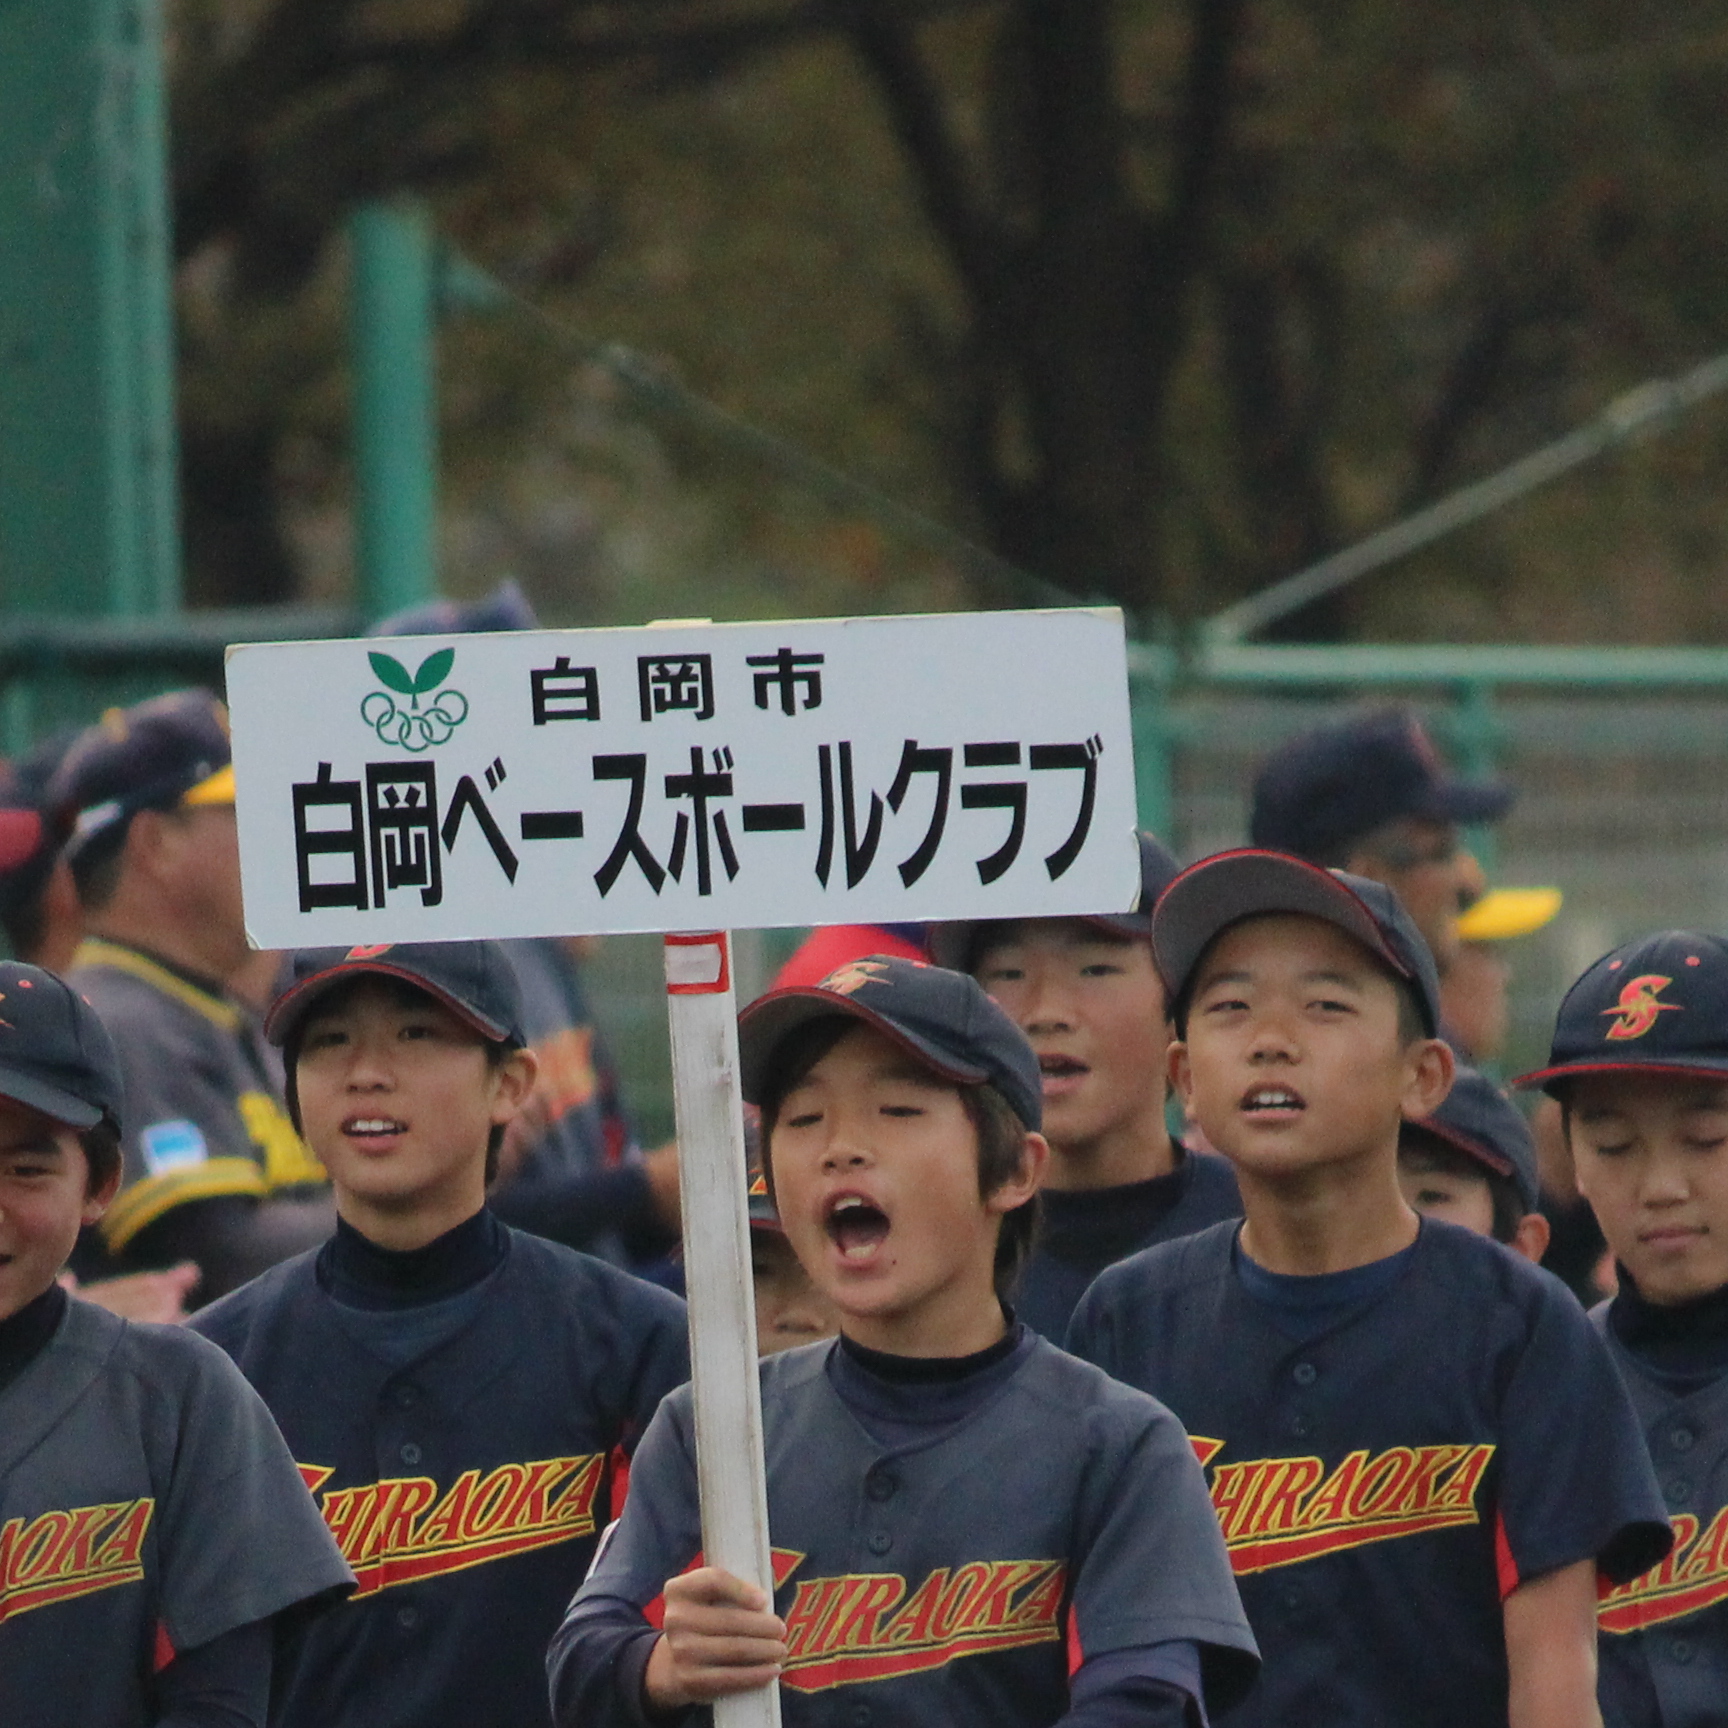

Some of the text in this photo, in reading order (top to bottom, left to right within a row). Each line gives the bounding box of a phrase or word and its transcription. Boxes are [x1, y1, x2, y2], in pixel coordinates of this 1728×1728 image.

[530, 647, 825, 725] 白岡市
[292, 733, 1104, 912] 白岡ベースボールクラブ
[295, 1451, 605, 1567] HIRAOKA
[1188, 1435, 1496, 1541] HIRAOKA
[772, 1547, 1069, 1661] HIRAOKA
